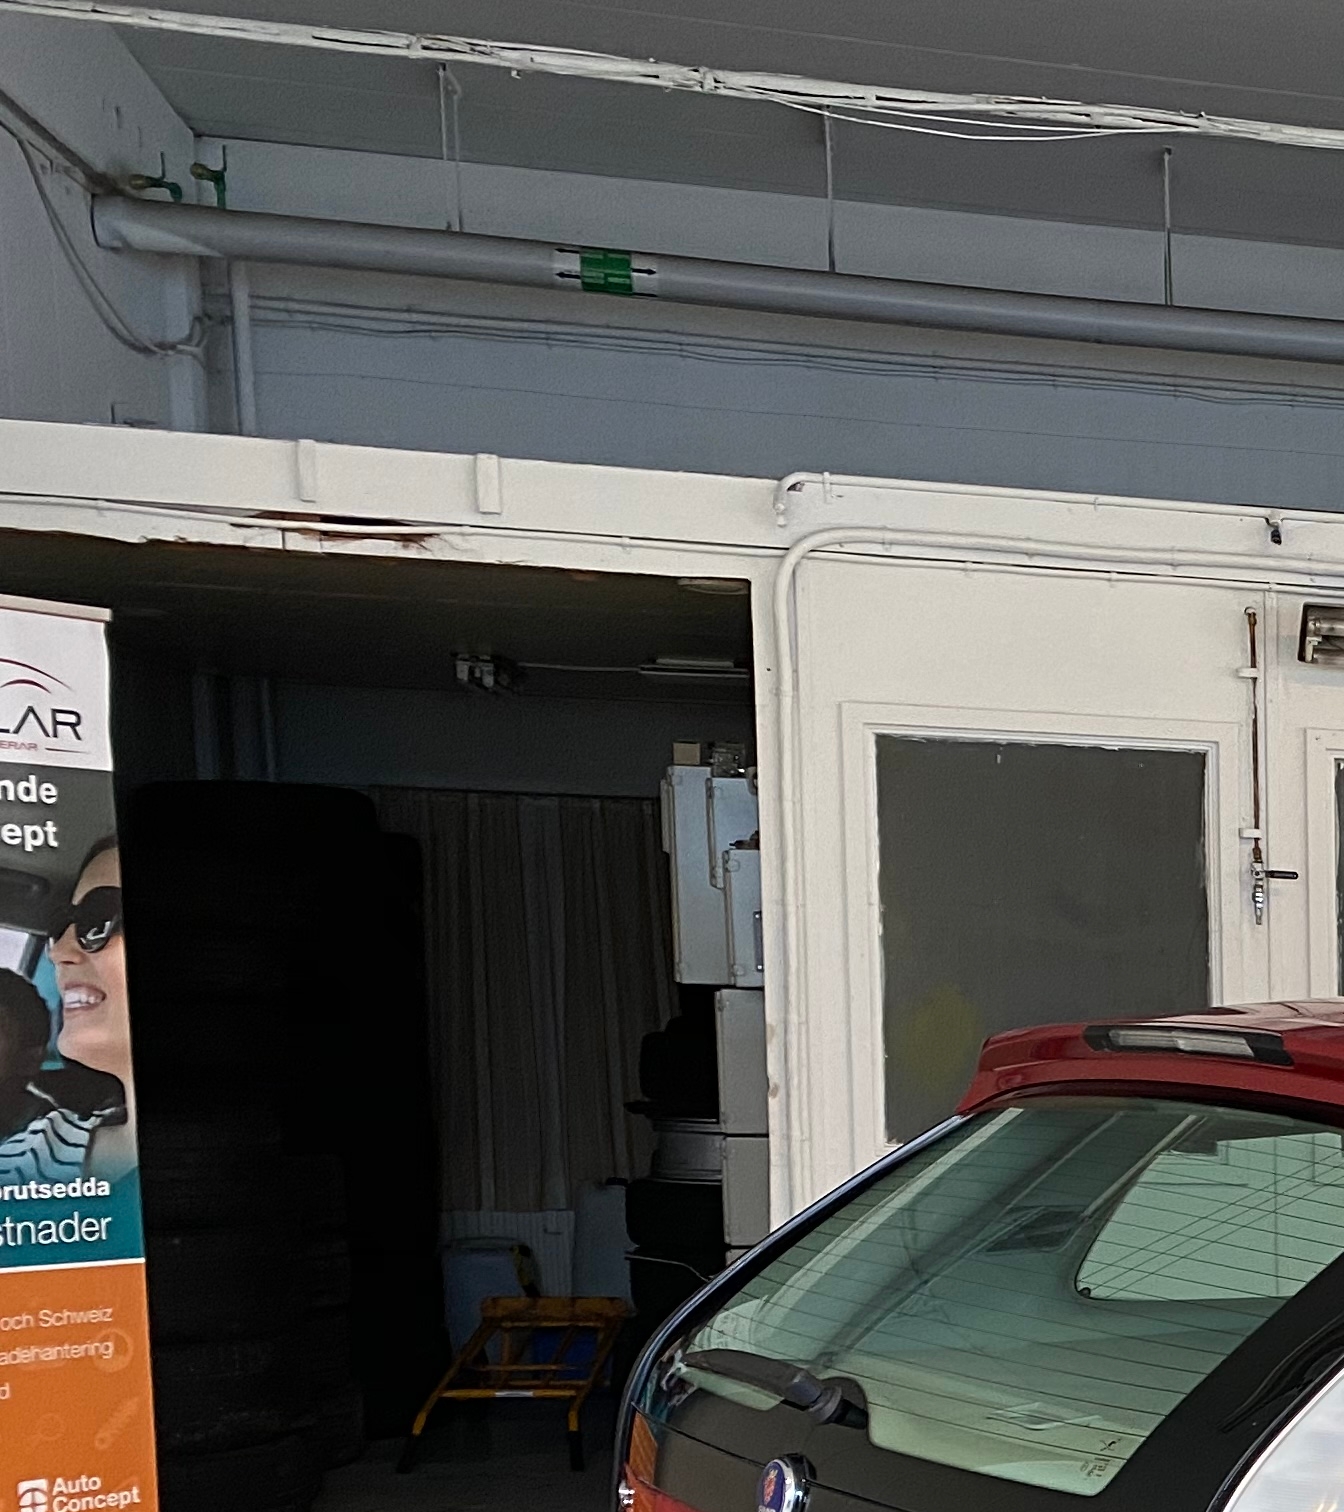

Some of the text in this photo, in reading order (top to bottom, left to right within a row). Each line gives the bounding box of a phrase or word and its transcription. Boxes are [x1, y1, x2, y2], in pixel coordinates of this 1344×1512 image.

[0, 774, 58, 804] nde
[0, 820, 59, 852] ept
[0, 1177, 110, 1201] rutsedda
[0, 1306, 113, 1331] och Schweiz
[52, 1474, 102, 1496] Auto
